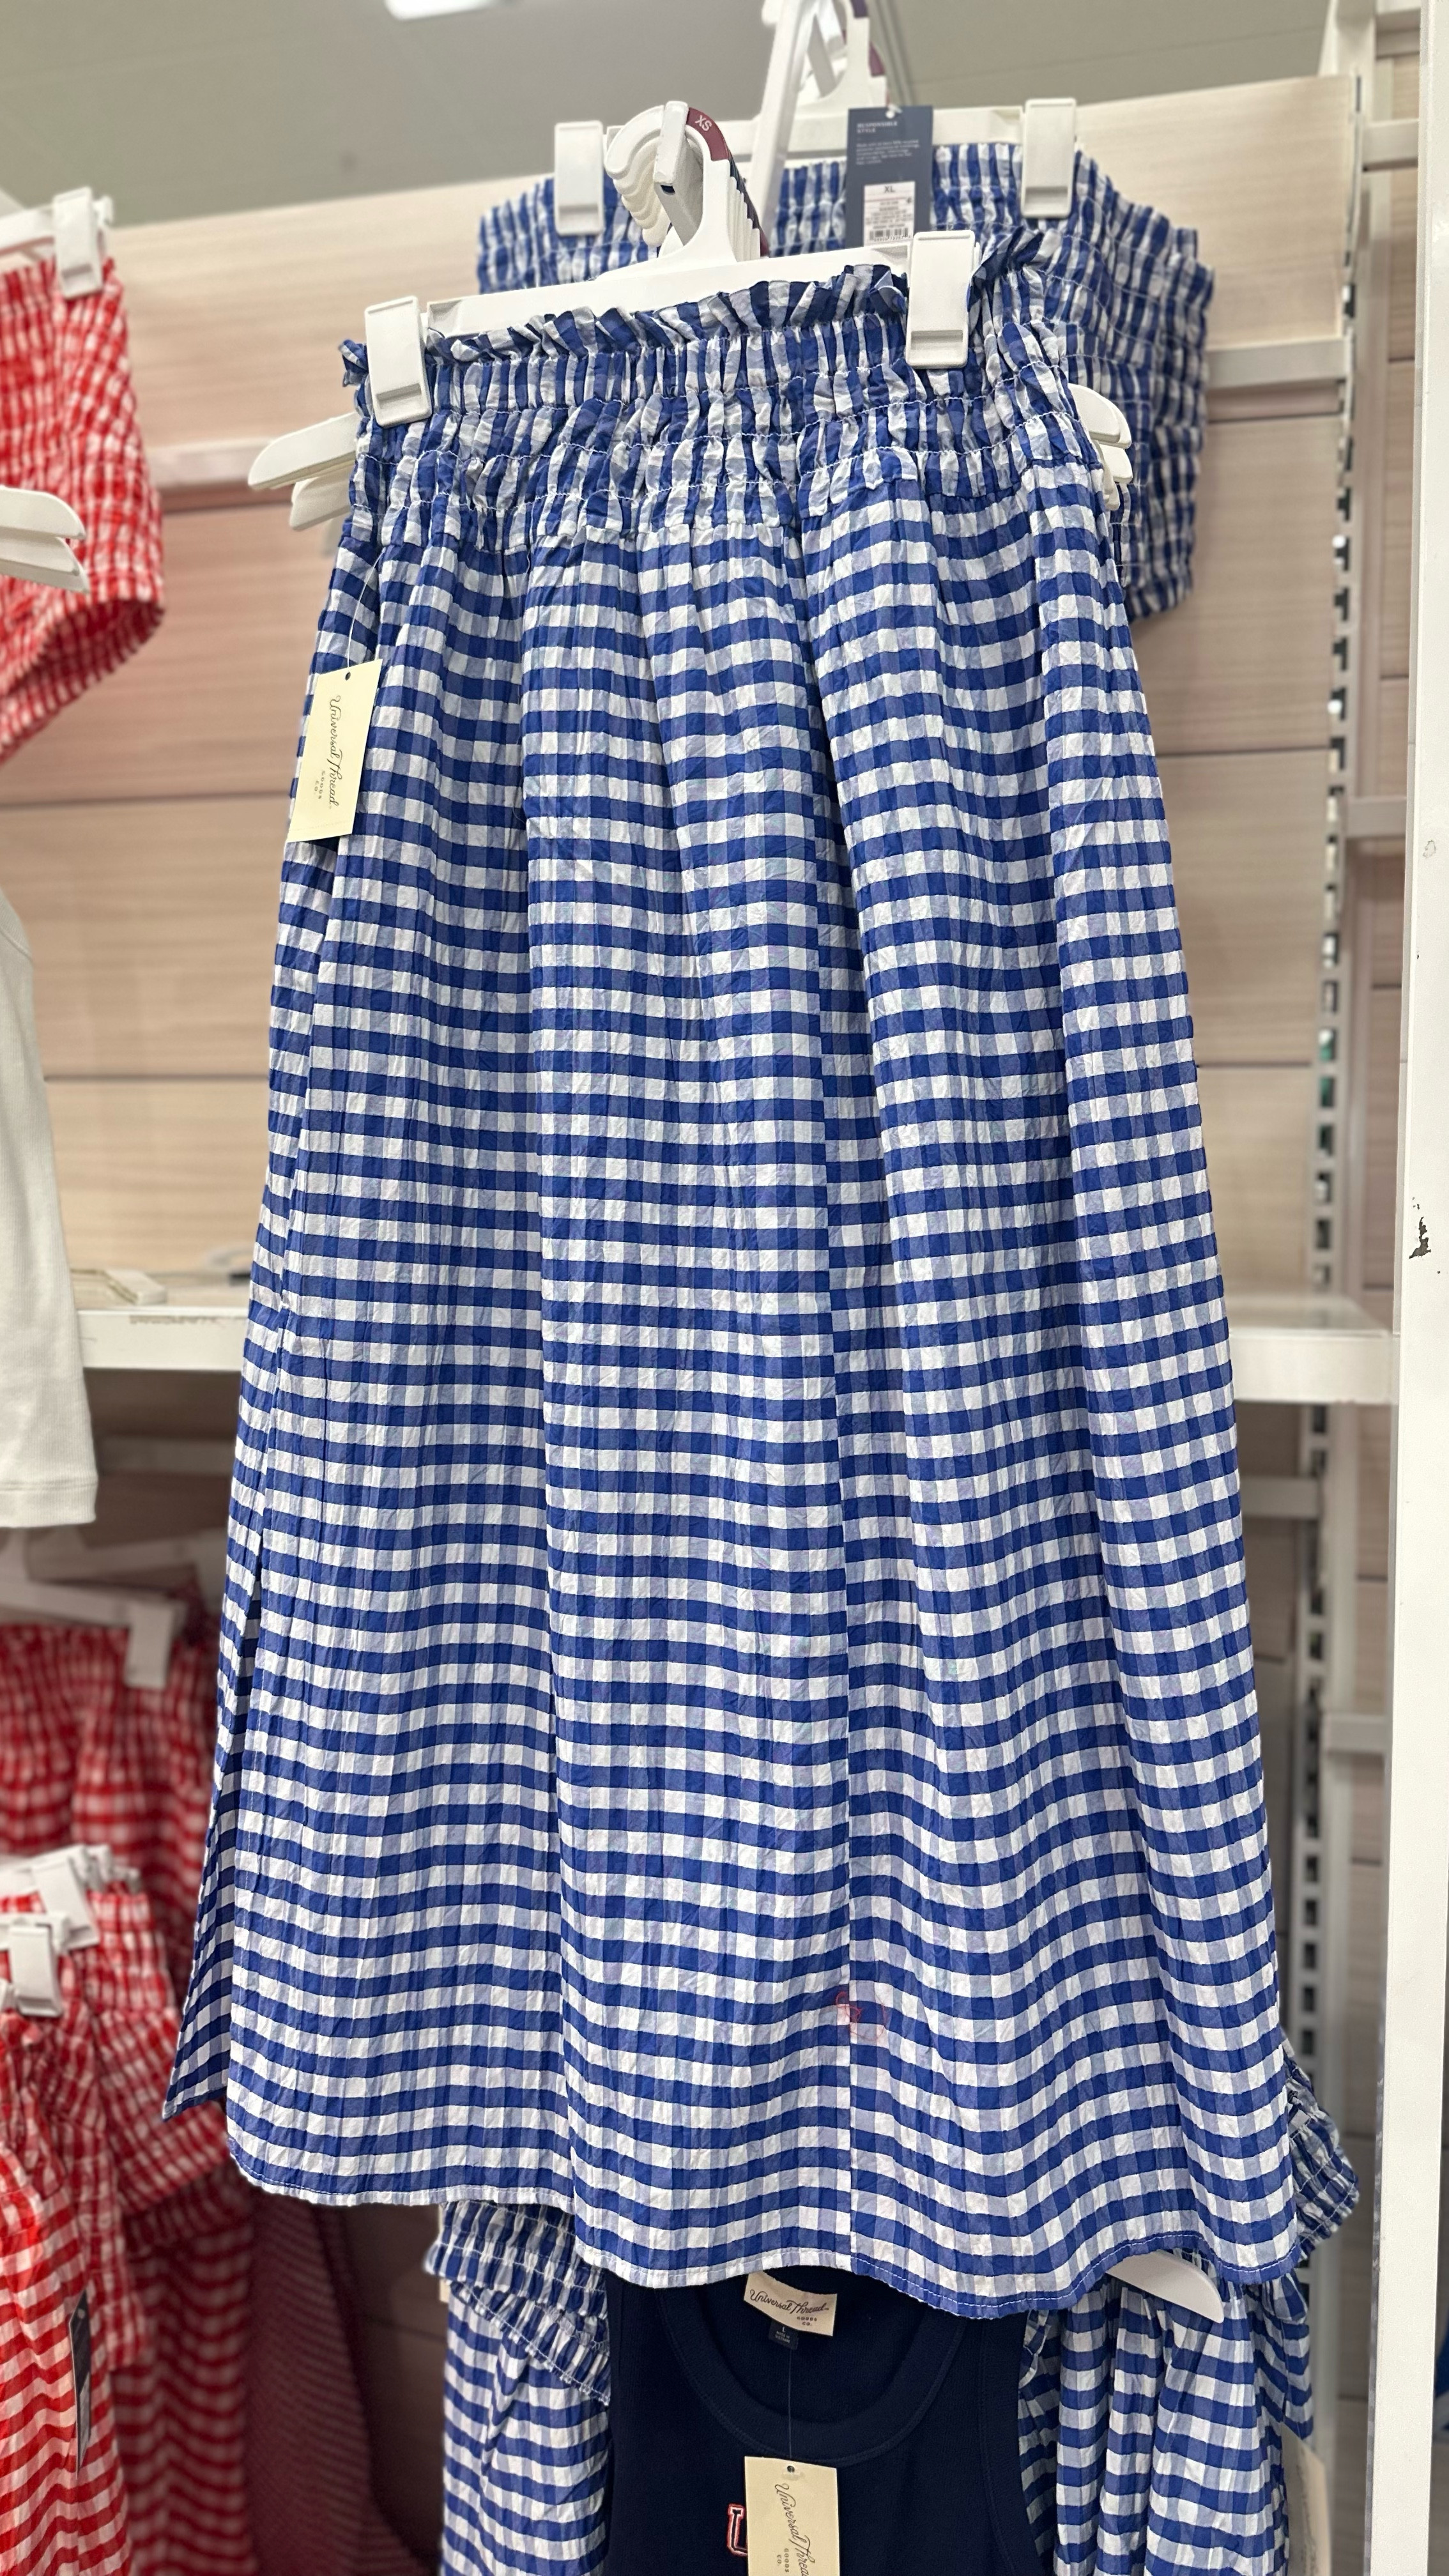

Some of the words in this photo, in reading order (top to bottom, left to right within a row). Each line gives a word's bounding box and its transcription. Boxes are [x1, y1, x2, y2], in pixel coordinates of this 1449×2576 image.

[694, 114, 712, 132] XS
[328, 694, 342, 758] Universal
[326, 749, 343, 807] Thread
[749, 2289, 793, 2312] Universal
[786, 2299, 827, 2315] Thread
[774, 2483, 808, 2543] Universal
